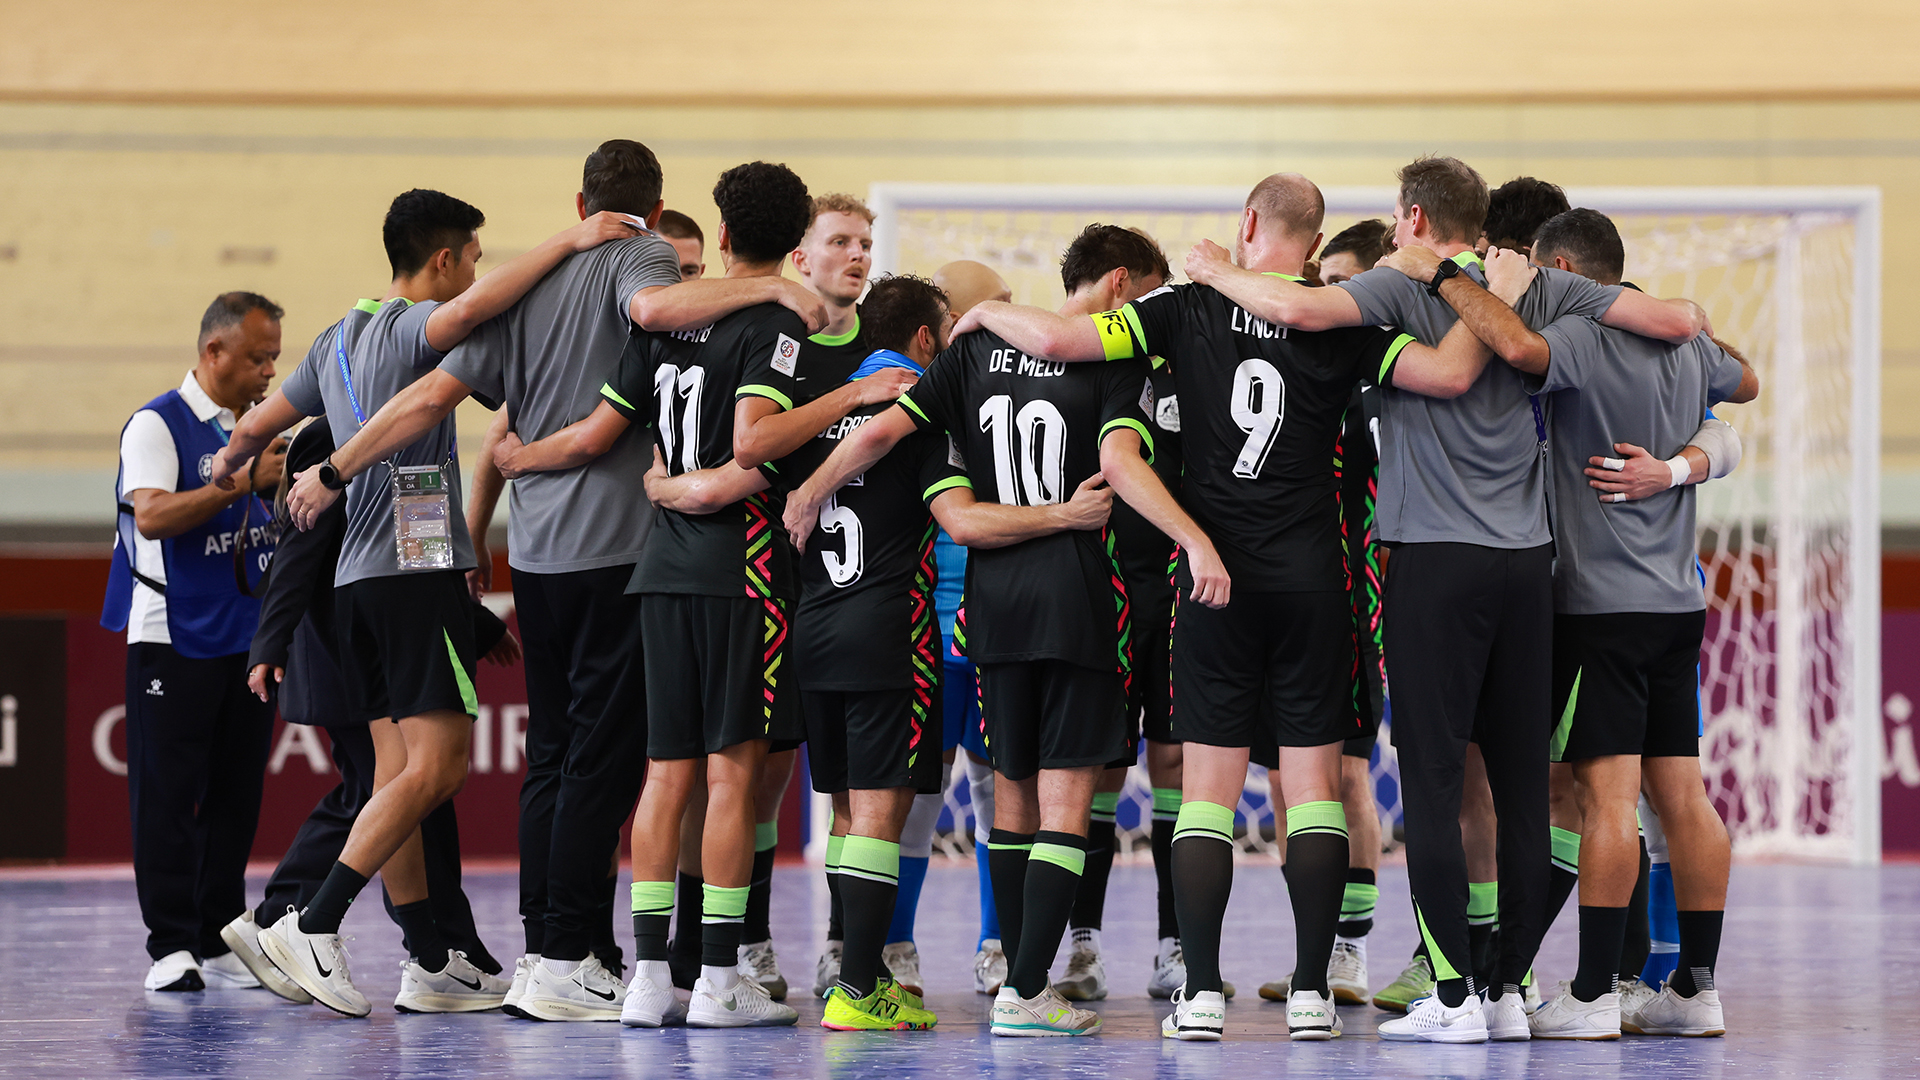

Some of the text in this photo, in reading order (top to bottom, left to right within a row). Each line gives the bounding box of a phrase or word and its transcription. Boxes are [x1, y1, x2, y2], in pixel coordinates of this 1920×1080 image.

[989, 348, 1016, 373] DE
[653, 363, 705, 477] 11
[979, 394, 1067, 506] 10
[1231, 358, 1285, 479] 9
[427, 474, 433, 484] 1
[819, 474, 864, 588] 5
[258, 551, 274, 573] 0
